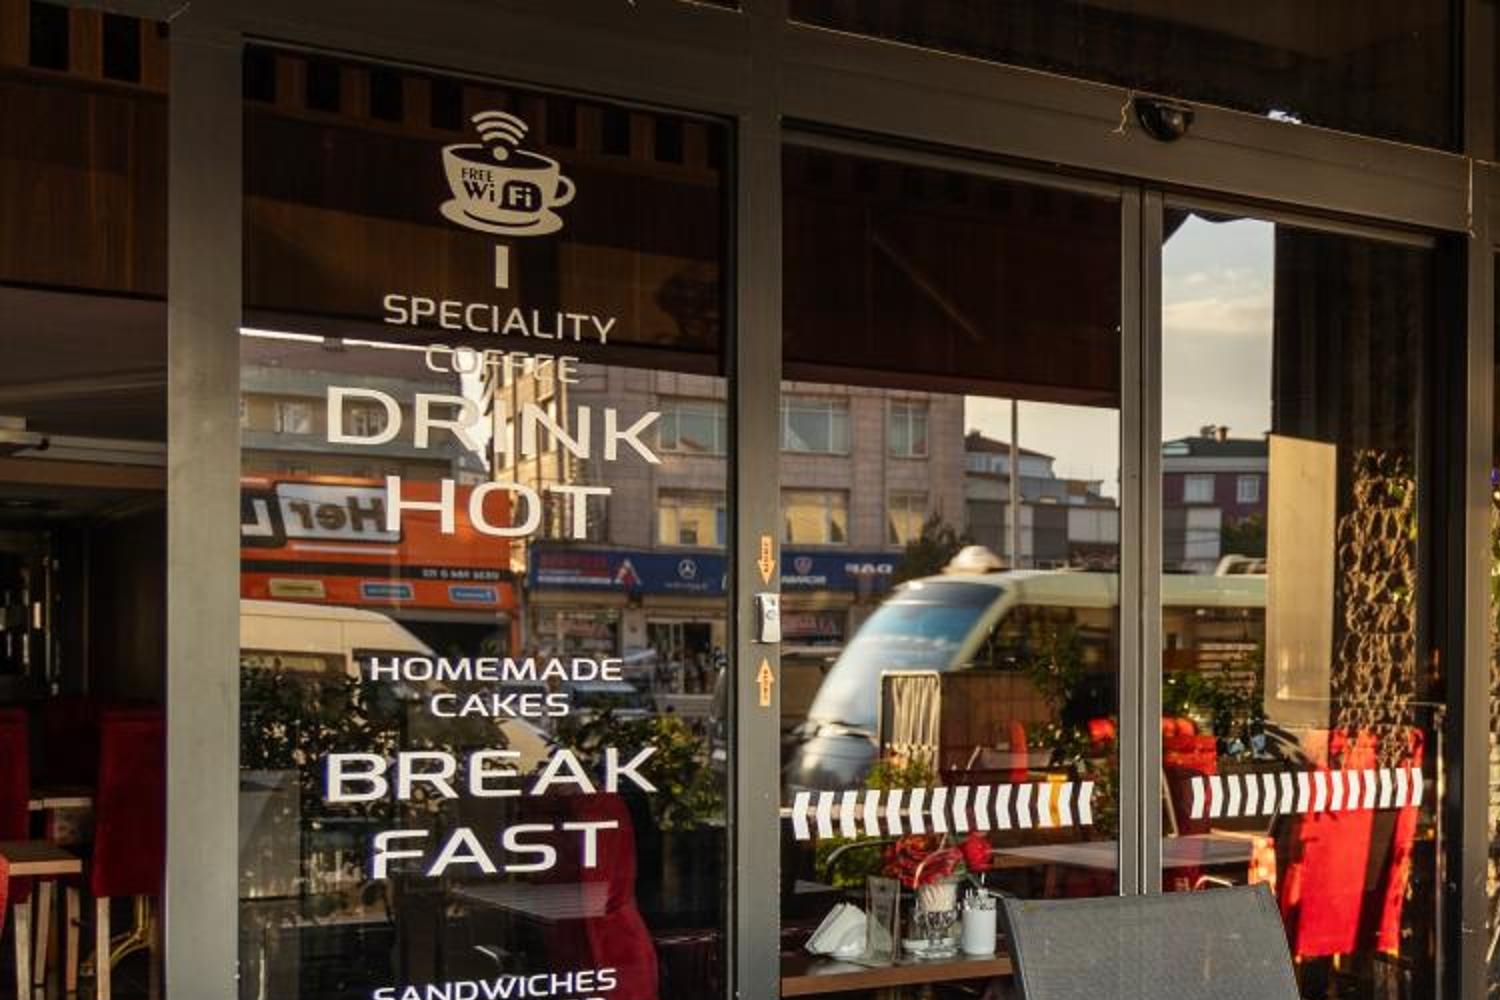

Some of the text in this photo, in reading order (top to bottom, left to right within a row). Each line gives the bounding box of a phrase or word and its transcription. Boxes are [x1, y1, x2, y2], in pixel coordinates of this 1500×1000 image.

[461, 167, 494, 183] FREE
[383, 294, 616, 345] SPECIALITY
[425, 344, 580, 385] COFFEE
[327, 385, 662, 465] DRINK
[385, 475, 612, 539] HOT
[370, 656, 624, 682] HOMEMADE
[431, 692, 570, 718] CAKES
[325, 746, 659, 803] BREAK
[372, 820, 619, 880] FAST
